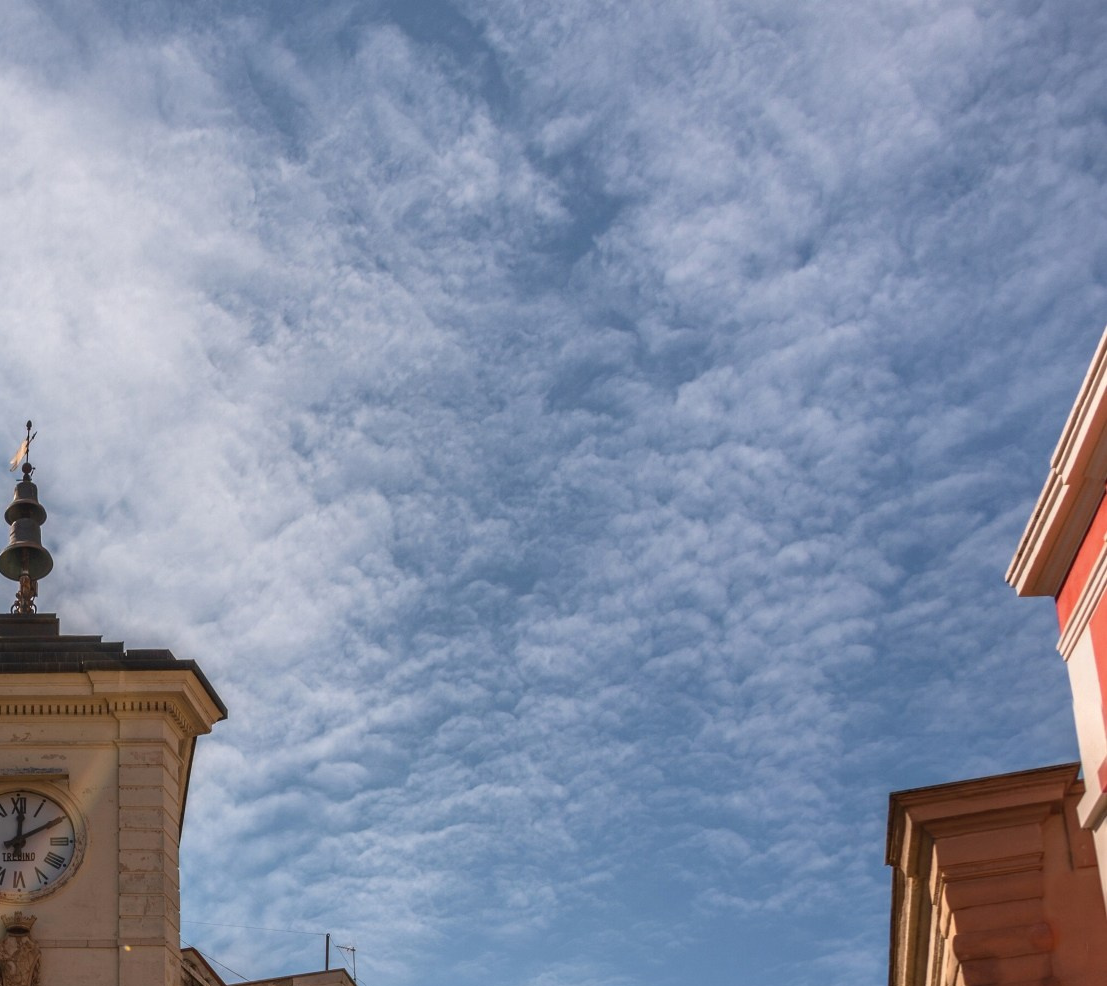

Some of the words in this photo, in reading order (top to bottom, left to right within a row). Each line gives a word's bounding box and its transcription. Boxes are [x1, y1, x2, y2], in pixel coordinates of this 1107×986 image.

[50, 837, 69, 846] III
[12, 871, 26, 889] VI
[34, 866, 49, 884] V
